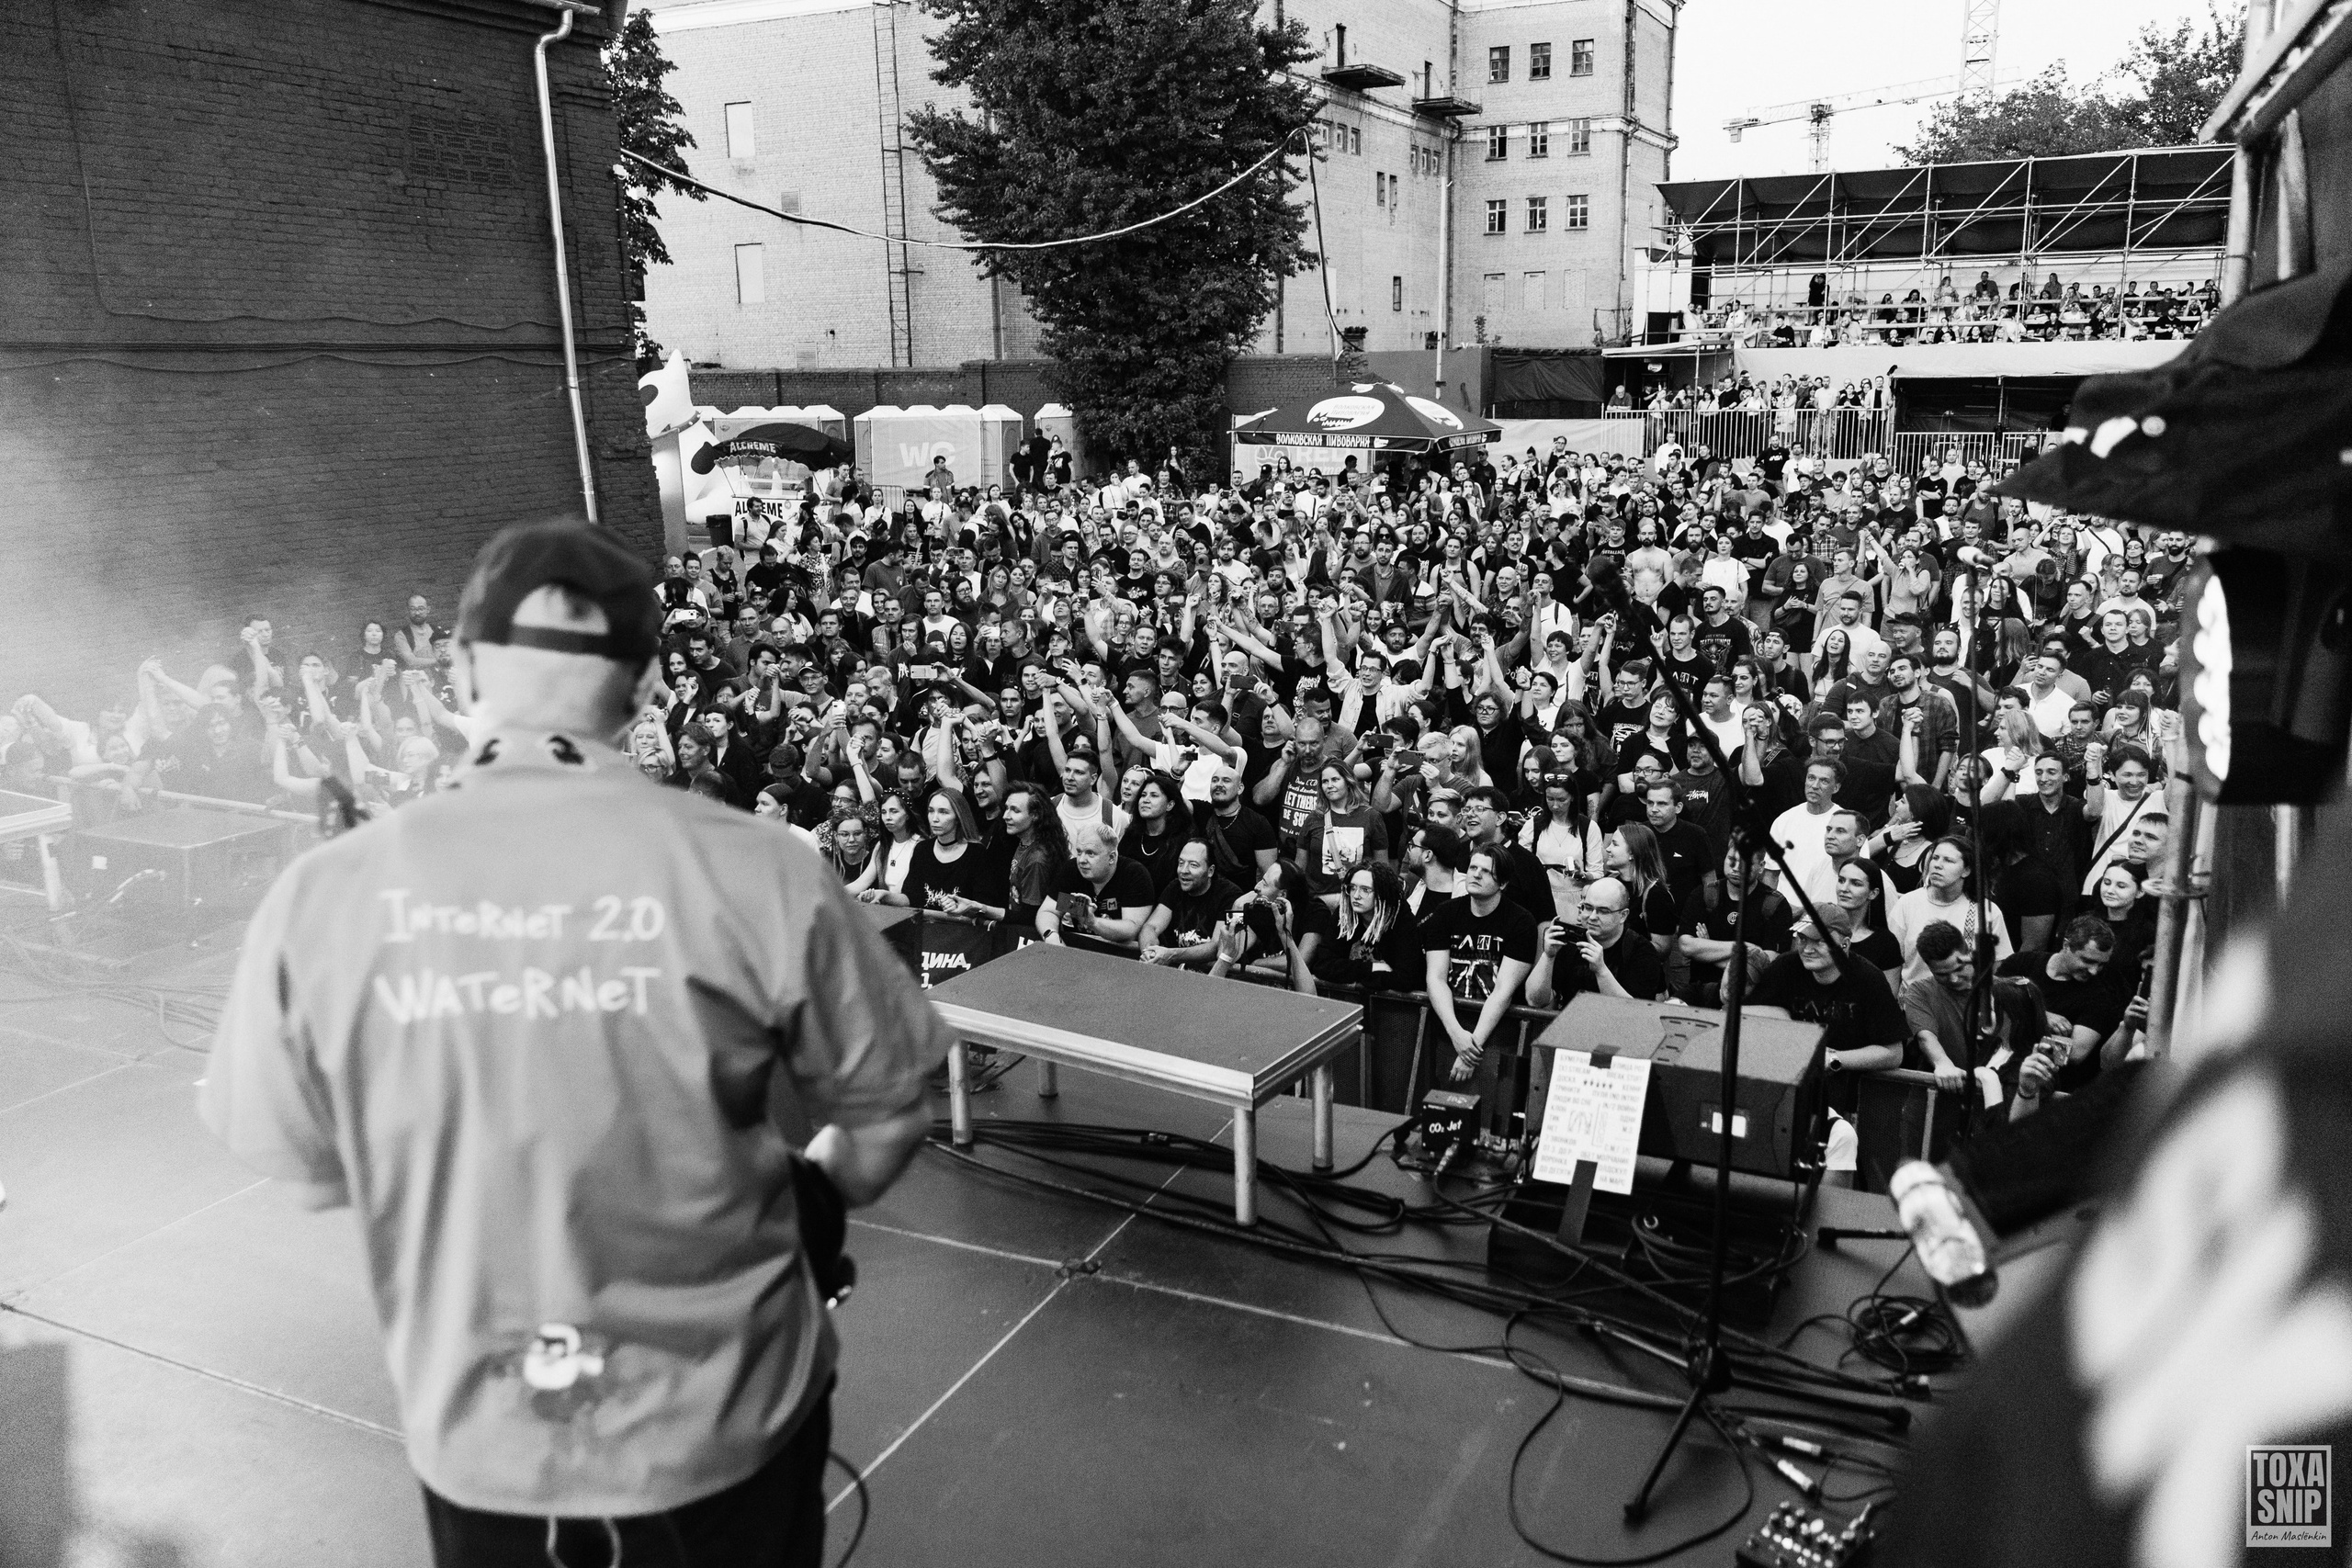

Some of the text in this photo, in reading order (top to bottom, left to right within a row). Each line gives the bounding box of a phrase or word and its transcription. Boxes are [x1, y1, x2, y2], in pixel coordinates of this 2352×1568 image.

[1275, 434, 1371, 447] ВОЛКОВСКАЯ ПИВОВАРНЯ
[899, 441, 956, 468] WC
[735, 501, 783, 519] ALEME
[1283, 791, 1297, 807] LET
[588, 895, 666, 942] 2.0
[1447, 1119, 1463, 1132] Jet
